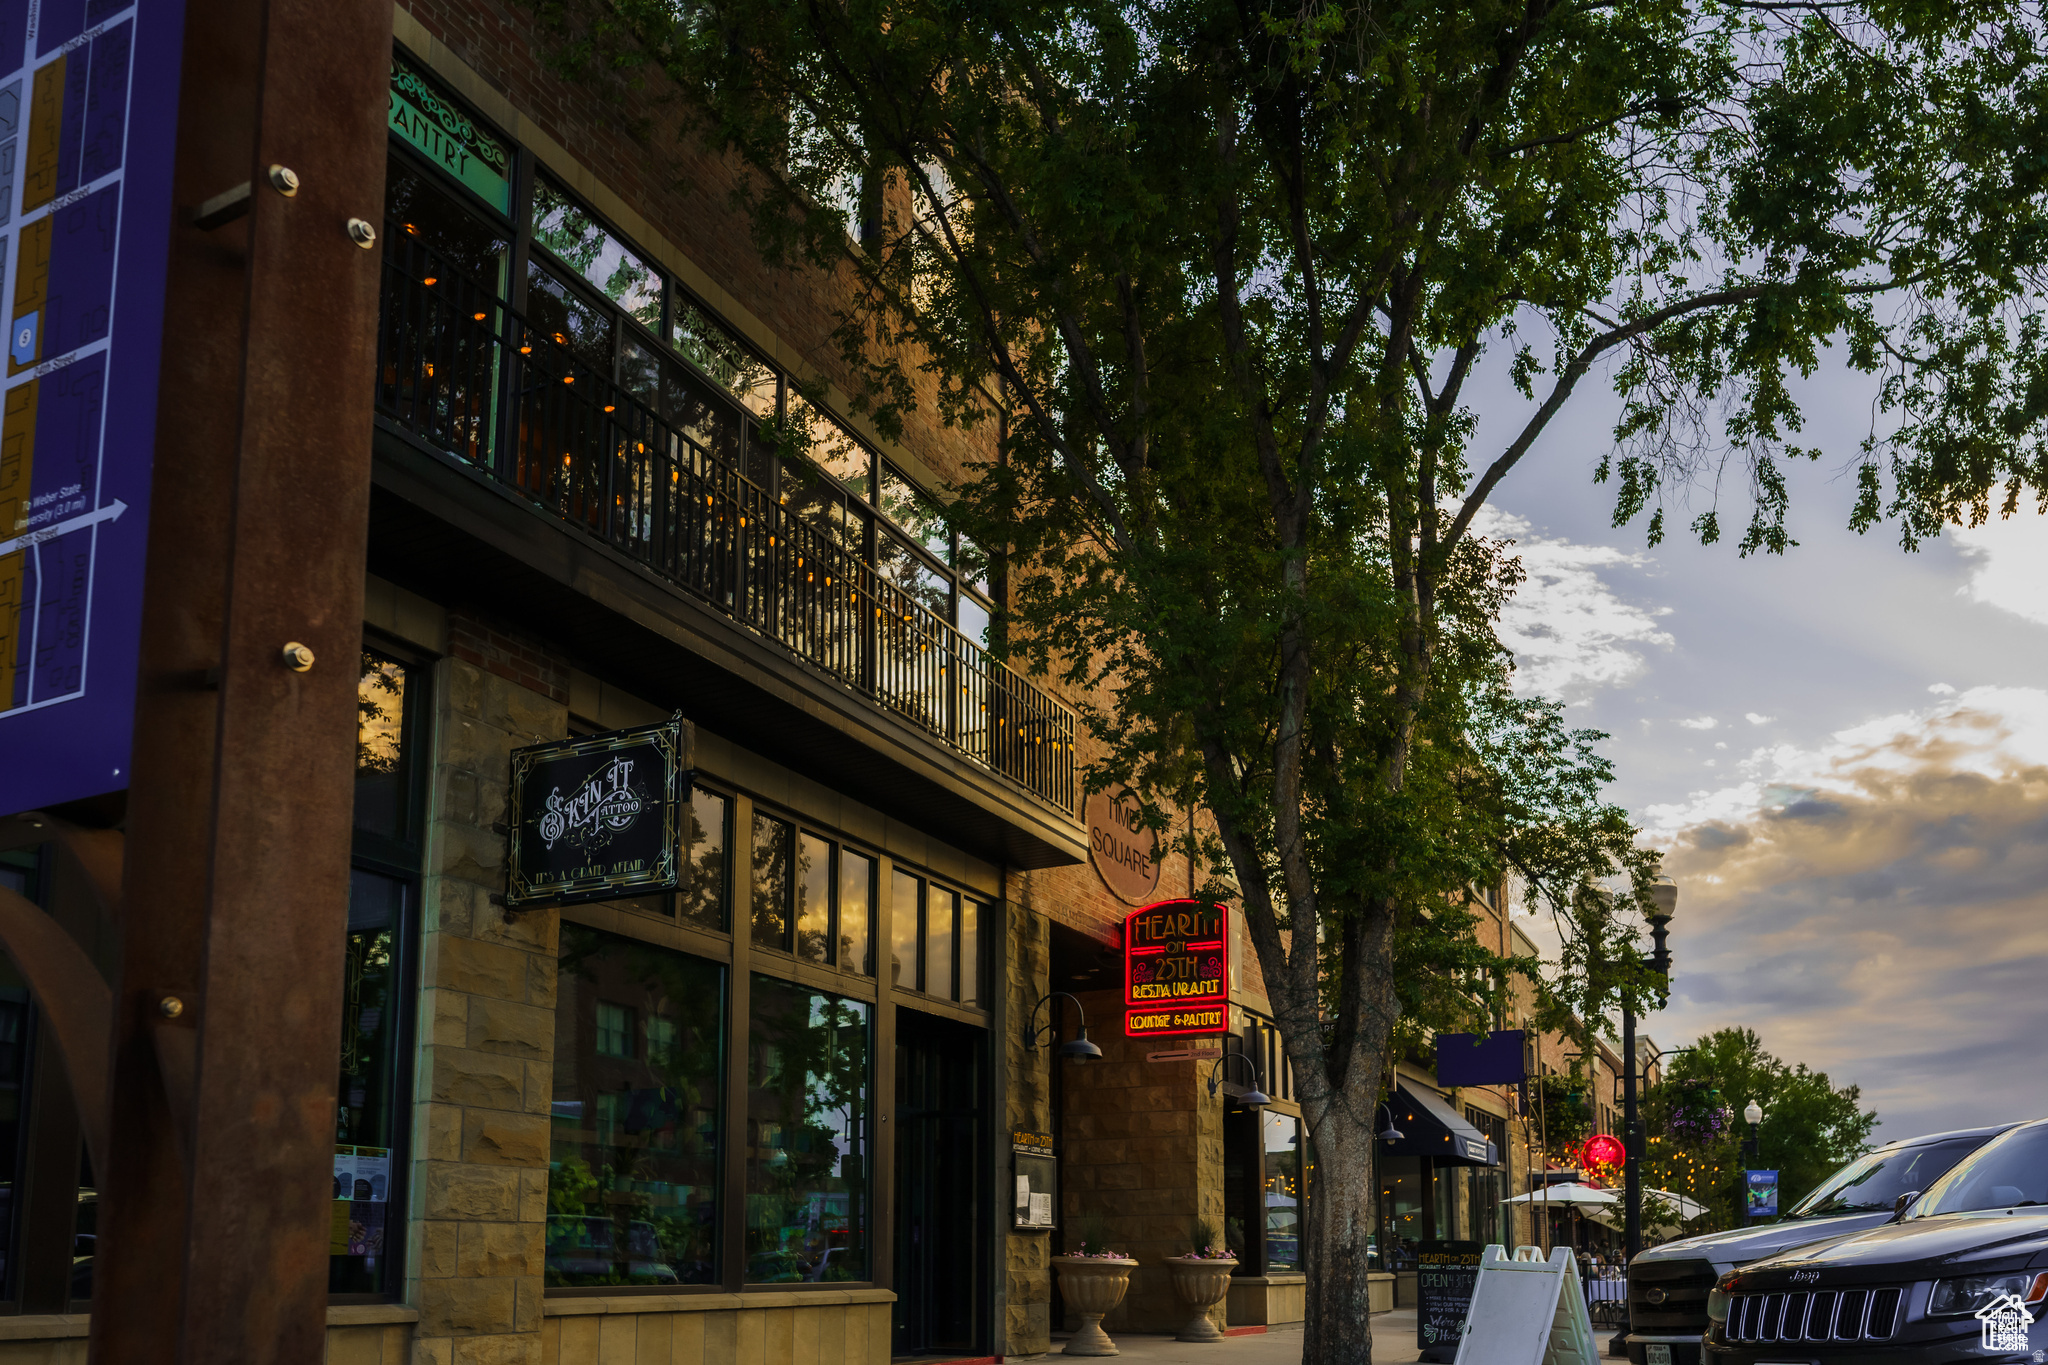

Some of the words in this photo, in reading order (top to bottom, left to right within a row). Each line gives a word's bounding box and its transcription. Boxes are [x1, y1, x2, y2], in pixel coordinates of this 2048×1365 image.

[27, 0, 39, 40] Washin
[33, 491, 58, 508] Weber
[59, 483, 81, 499] State
[14, 508, 53, 531] University
[606, 756, 635, 792] IT
[1107, 793, 1140, 835] TIME
[1092, 826, 1151, 880] SQUARE
[560, 869, 567, 881] A
[570, 863, 607, 880] GRAND
[611, 858, 645, 874] AFFAIR
[1155, 956, 1198, 981] 25TH
[1130, 1014, 1171, 1029] LOUNGE
[1013, 1131, 1035, 1145] HEARTH
[1418, 1252, 1450, 1264] HEARTH
[1460, 1253, 1481, 1265] 25TH
[1420, 1272, 1448, 1288] OPEN
[1789, 1270, 1820, 1284] Jeep
